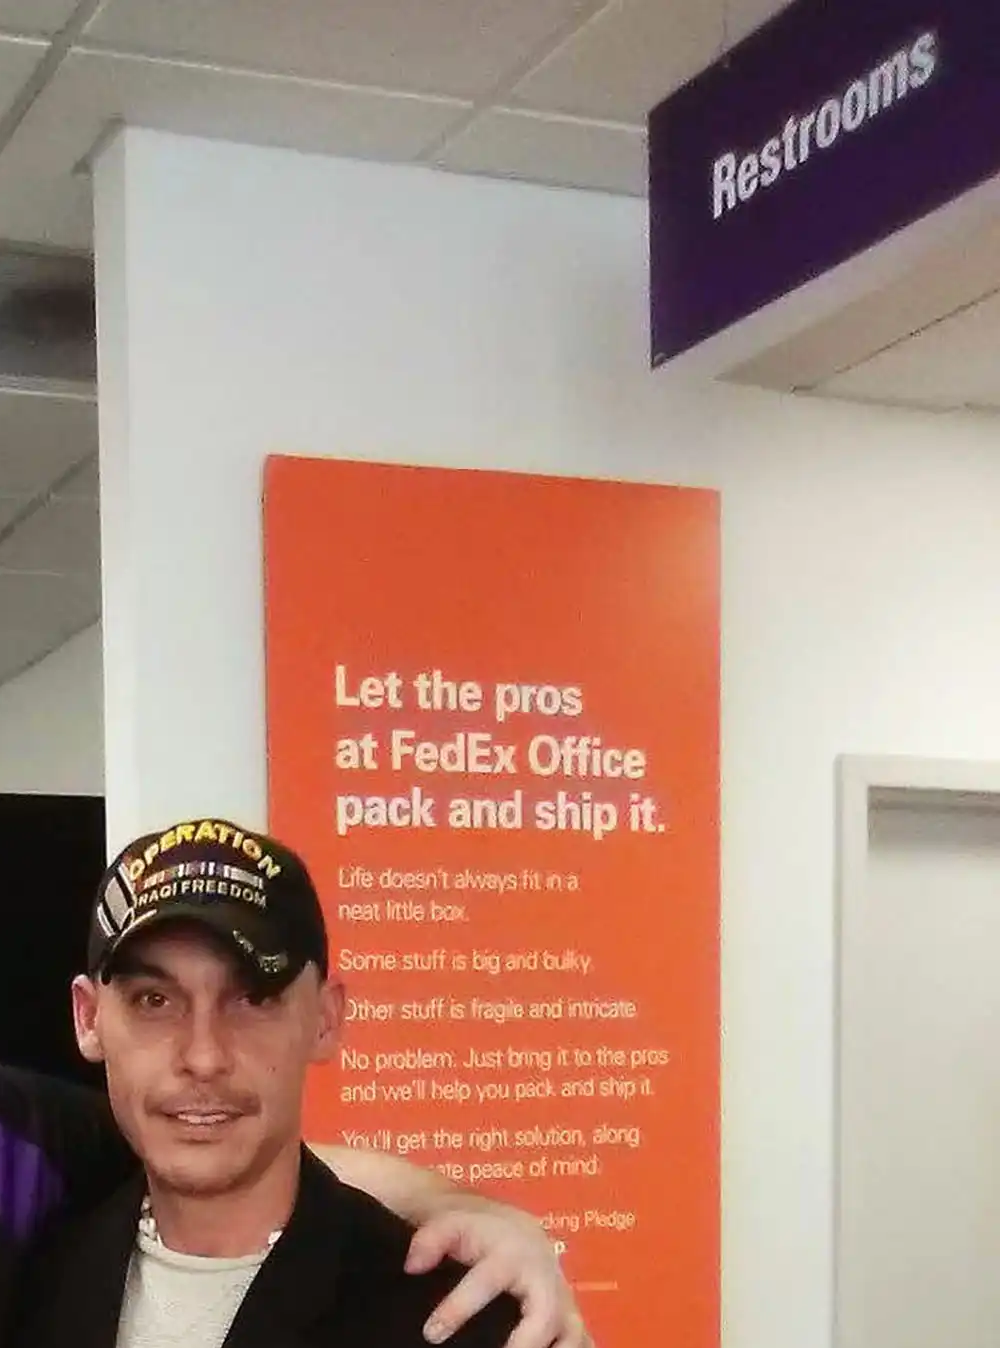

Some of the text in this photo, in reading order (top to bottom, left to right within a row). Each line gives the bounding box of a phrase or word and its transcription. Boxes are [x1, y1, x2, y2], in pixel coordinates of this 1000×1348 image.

[713, 32, 937, 219] Restrooms
[336, 665, 583, 721] Let the pros
[336, 730, 646, 778] at FedEx Office
[336, 787, 665, 840] pack and ship it.
[130, 820, 281, 881] OPERATION
[181, 880, 266, 909] FREEDOM
[338, 867, 579, 894] Life doesn't always fit in a
[338, 900, 470, 922] neat little box.
[339, 949, 396, 972] Some
[402, 949, 447, 970] stuff
[451, 952, 467, 970] is
[472, 949, 500, 974] big
[506, 951, 538, 970] and
[345, 999, 393, 1021] Other
[401, 998, 445, 1020] stuff
[450, 1000, 465, 1020] is
[472, 998, 524, 1023] fragile
[529, 998, 563, 1018] and
[341, 1045, 670, 1073] No problem. Just bring it to the pros
[341, 1080, 376, 1101] and
[383, 1079, 426, 1101] we'll
[431, 1079, 471, 1102] help
[476, 1083, 509, 1103] you
[515, 1078, 555, 1102] pack
[561, 1077, 594, 1097] and
[600, 1075, 636, 1100] ship
[341, 1124, 640, 1154] You'll get the right solution, along
[469, 1160, 524, 1183] peace
[529, 1156, 547, 1177] of
[584, 1210, 636, 1231] Pledge
